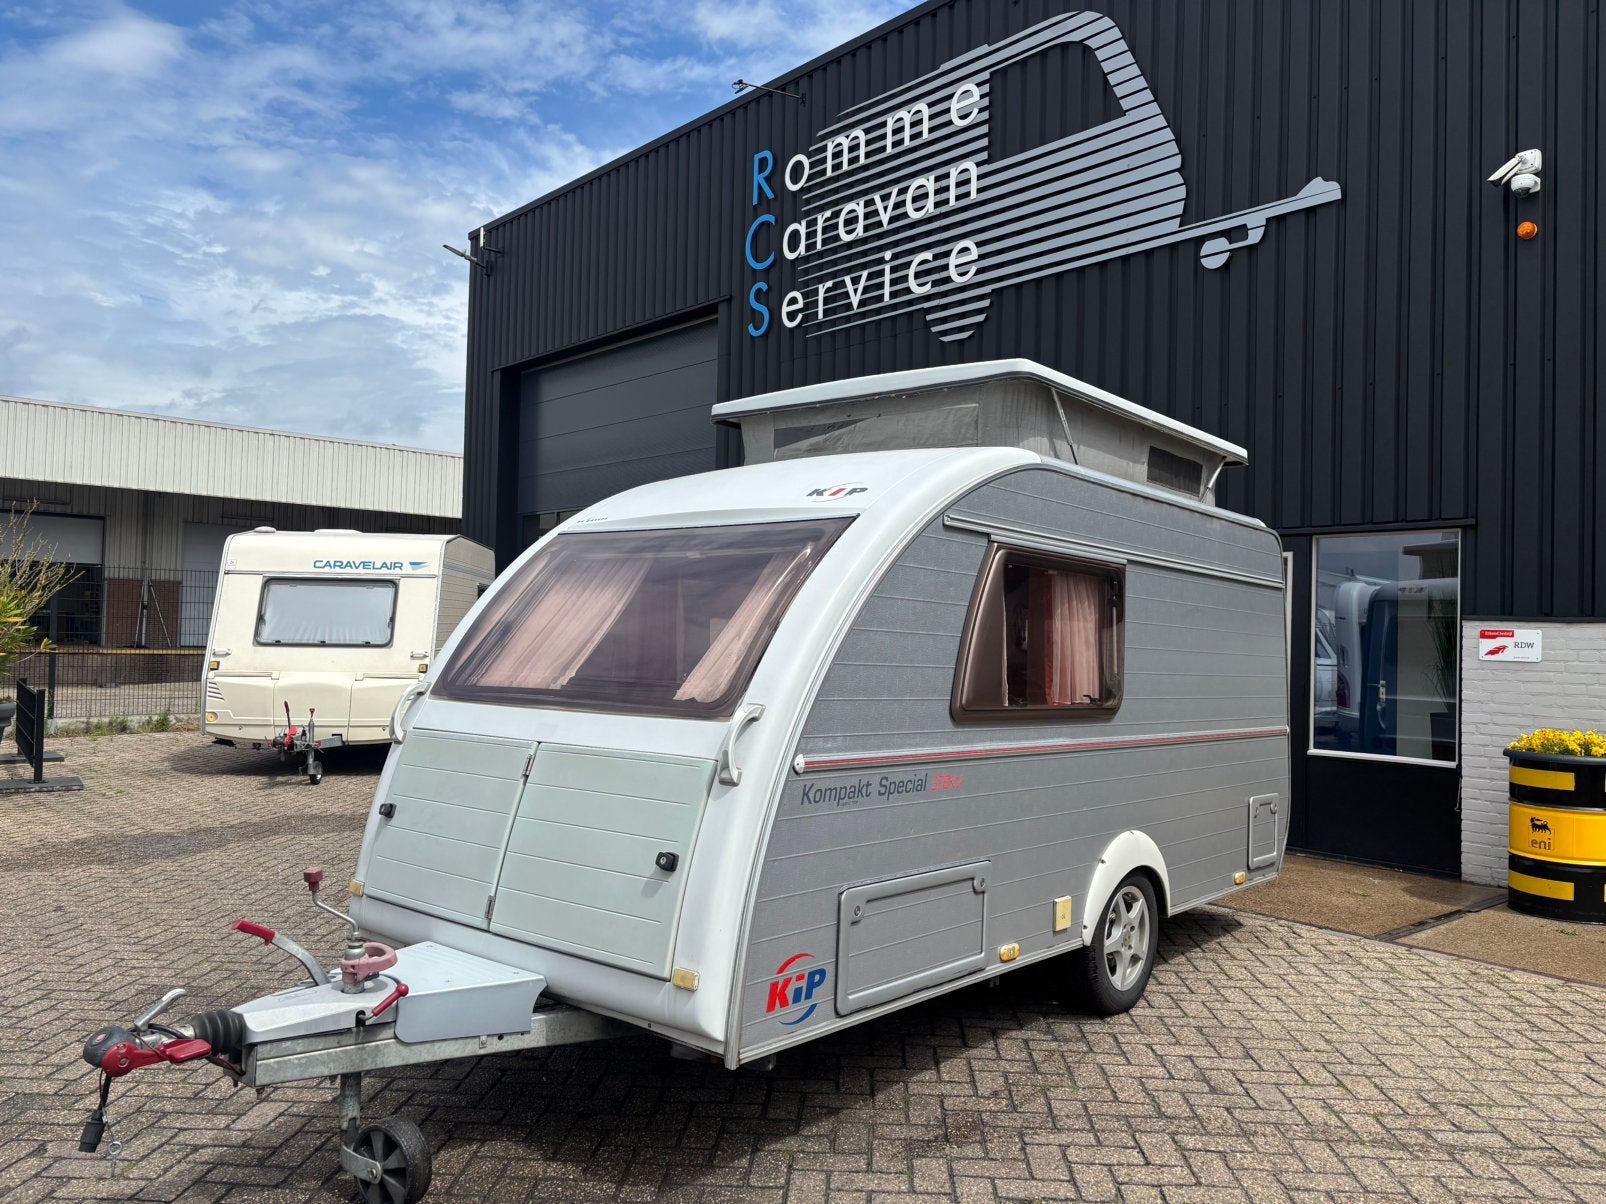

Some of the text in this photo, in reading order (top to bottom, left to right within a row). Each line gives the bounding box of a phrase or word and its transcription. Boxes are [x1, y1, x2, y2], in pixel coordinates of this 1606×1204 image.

[752, 83, 980, 206] Romme
[745, 161, 978, 270] Caravan
[748, 240, 978, 337] Service
[313, 560, 404, 571] CARAVELAIR
[1514, 641, 1535, 649] RDW
[801, 779, 873, 807] Kompakt
[878, 773, 928, 800] Special
[1531, 838, 1551, 850] eni
